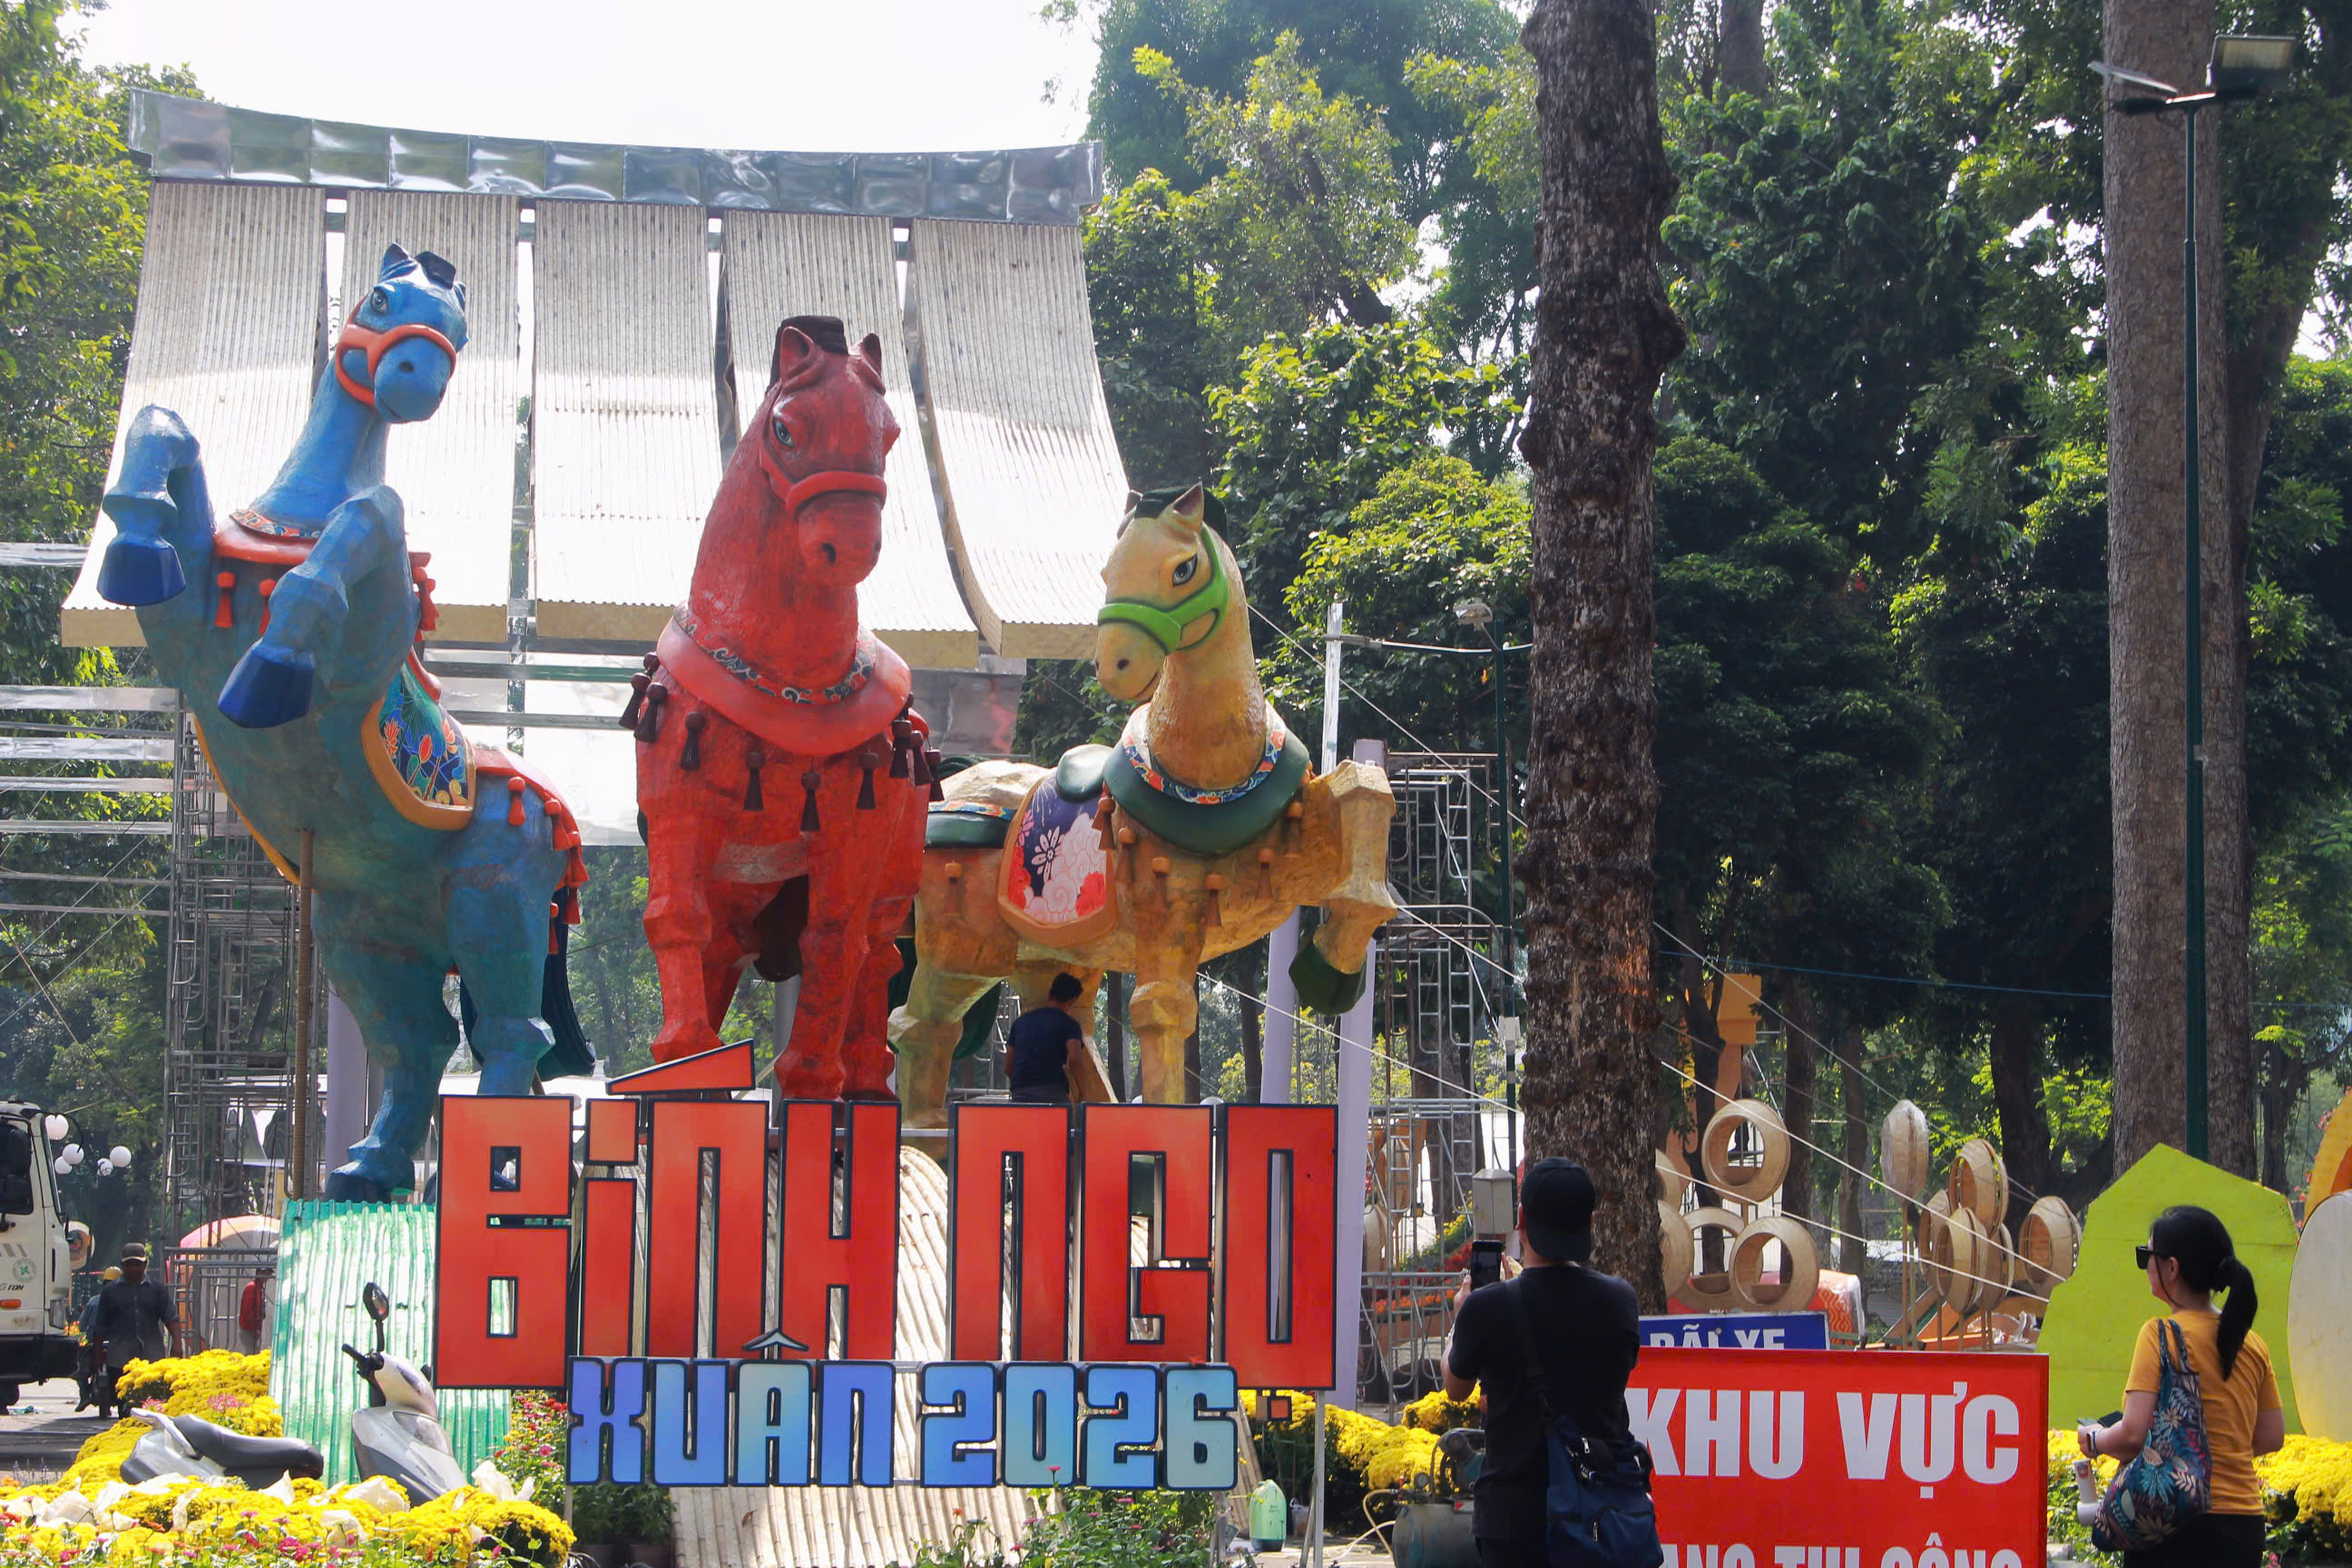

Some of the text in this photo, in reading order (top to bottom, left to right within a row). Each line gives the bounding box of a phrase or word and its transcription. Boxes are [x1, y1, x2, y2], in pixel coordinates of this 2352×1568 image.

[566, 1328, 1238, 1490] XUÂN 2026
[1623, 1381, 2020, 1498] KHU VỰC
